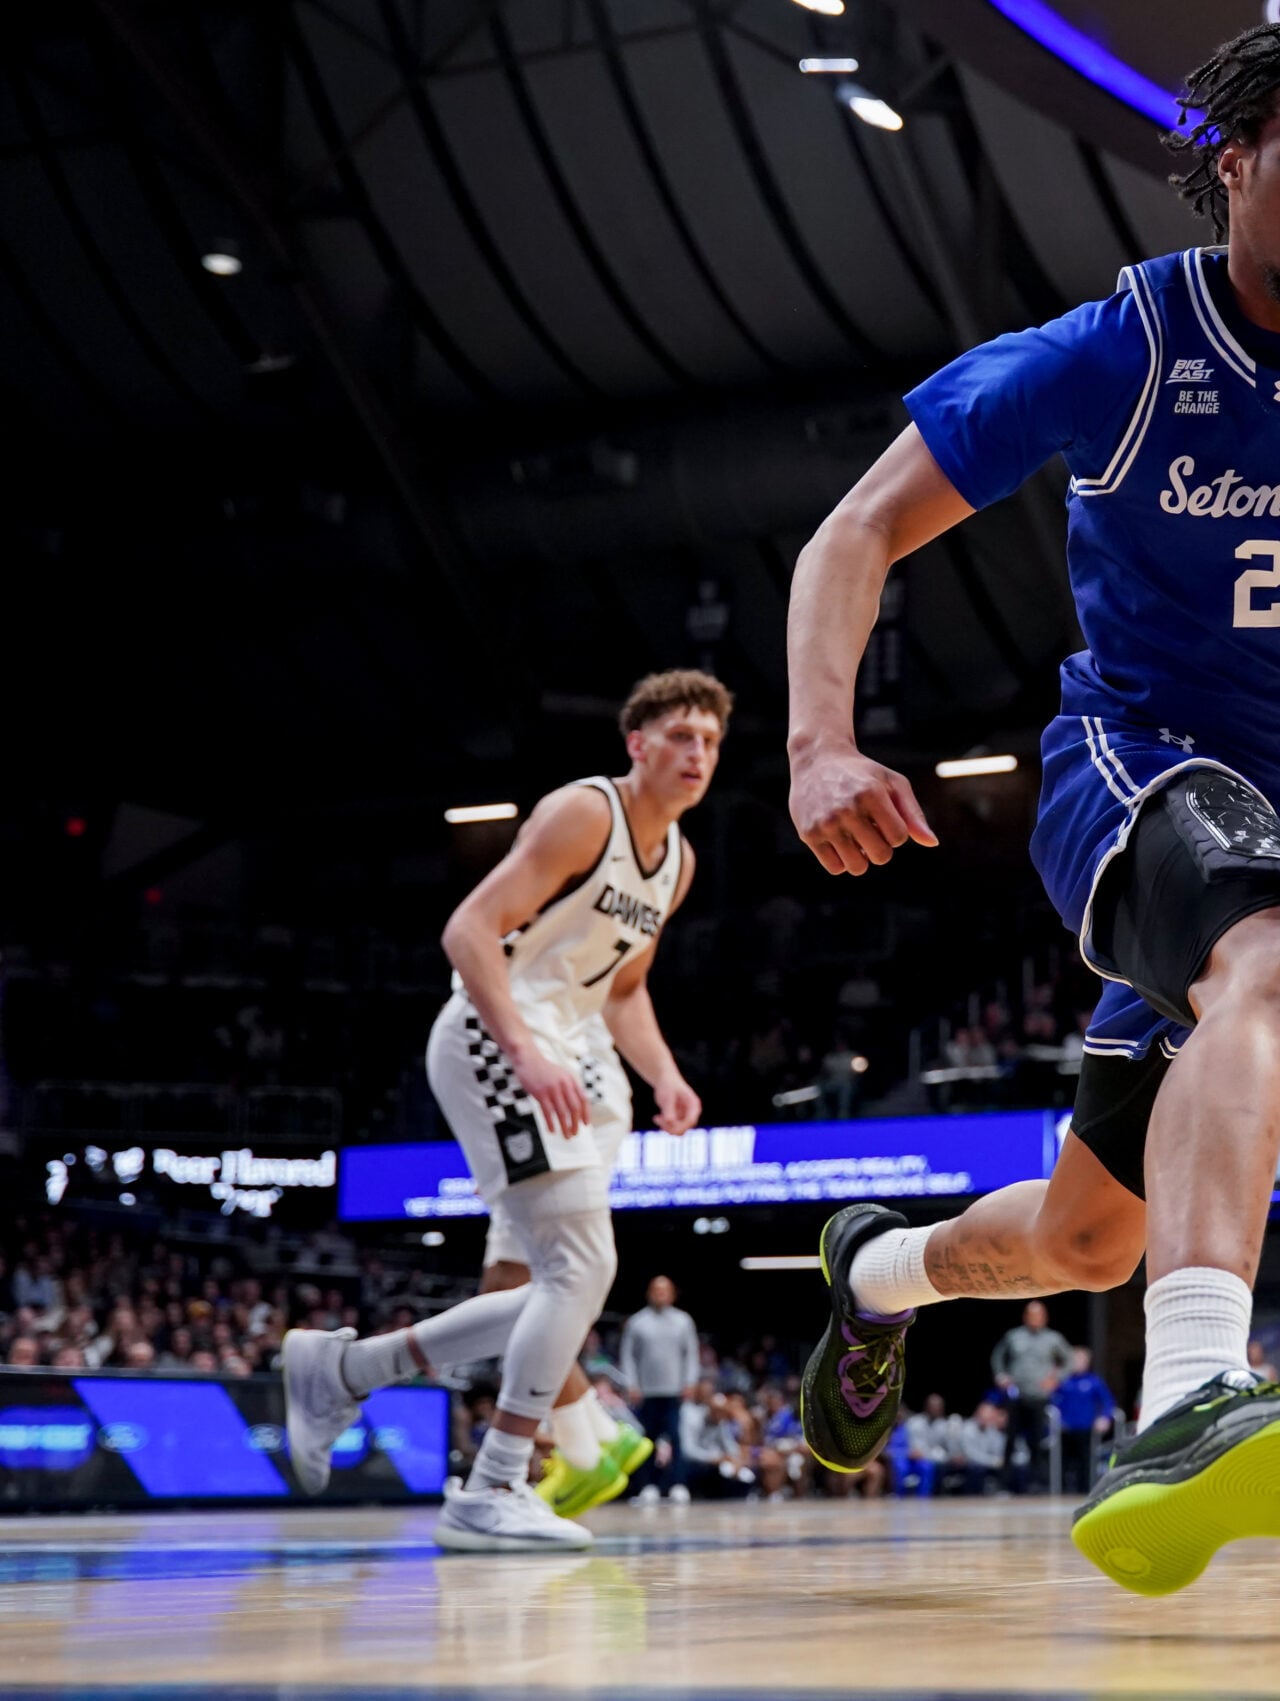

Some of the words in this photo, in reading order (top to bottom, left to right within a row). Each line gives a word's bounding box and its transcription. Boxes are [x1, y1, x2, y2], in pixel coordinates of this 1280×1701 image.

[1174, 358, 1207, 370] BIG
[1169, 369, 1215, 380] EAST
[1178, 390, 1194, 402] BE
[1197, 390, 1219, 402] THE
[1174, 401, 1220, 414] CHANGE
[582, 938, 632, 988] 7
